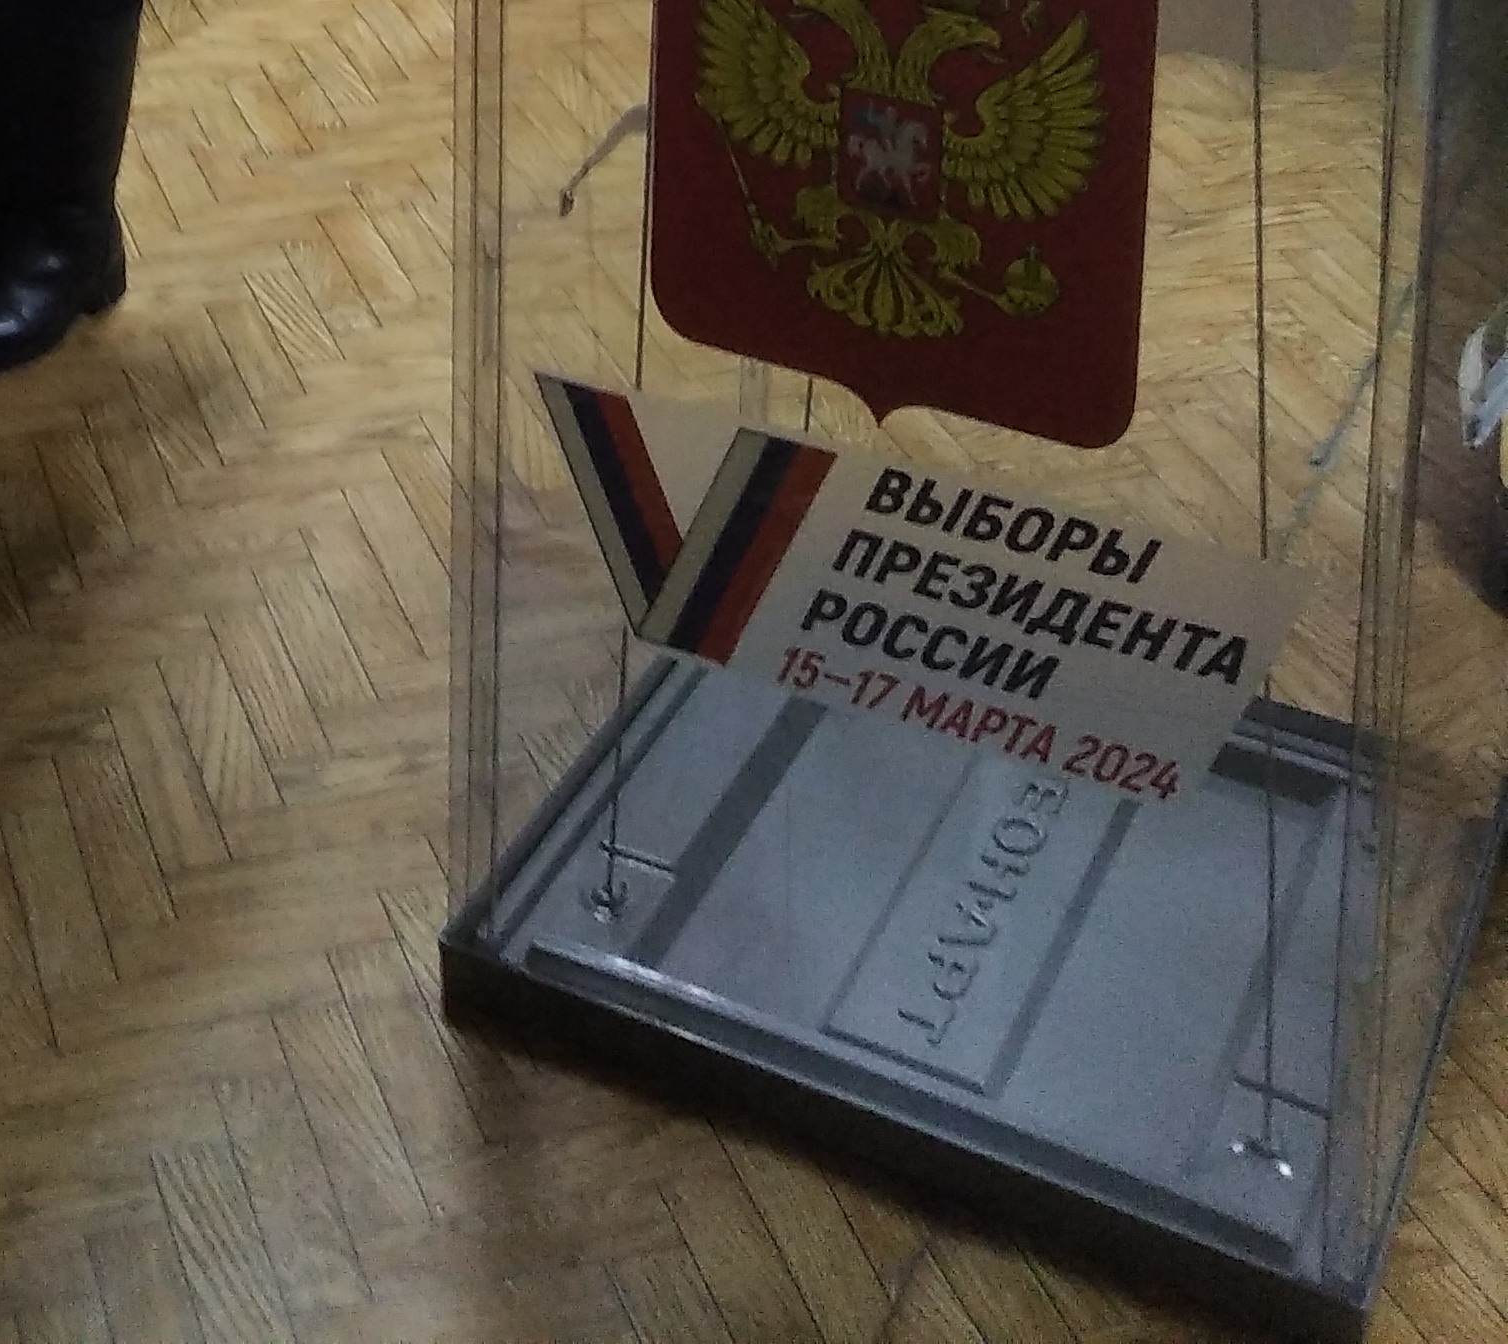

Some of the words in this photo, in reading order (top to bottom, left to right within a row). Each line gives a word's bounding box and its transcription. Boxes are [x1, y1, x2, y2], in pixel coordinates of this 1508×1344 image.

[863, 466, 1163, 584] ВЫБОРЫ
[799, 587, 1061, 700] РОССИИ
[831, 527, 1251, 685] ПРЕЗИДЕНТА
[900, 683, 1059, 765] МАРТА
[1061, 732, 1182, 801] 2024
